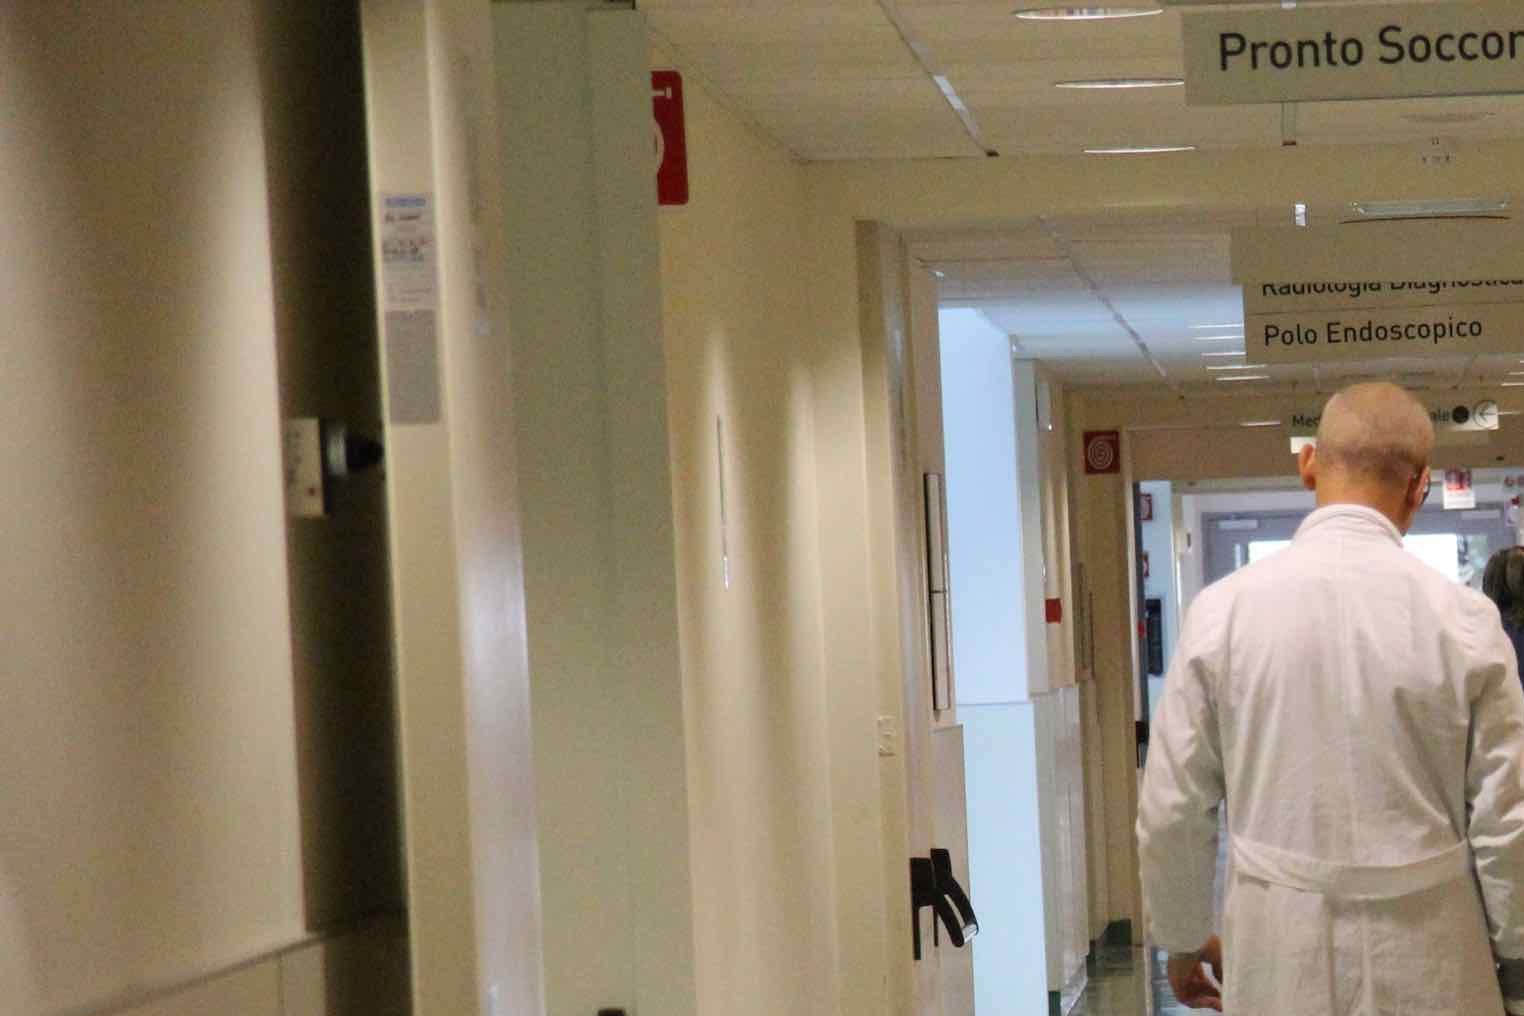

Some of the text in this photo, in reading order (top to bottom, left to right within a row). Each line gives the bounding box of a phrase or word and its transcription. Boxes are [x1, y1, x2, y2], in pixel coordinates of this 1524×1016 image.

[1219, 31, 1364, 71] Pronto
[1264, 316, 1483, 346] Polo Endoscopico
